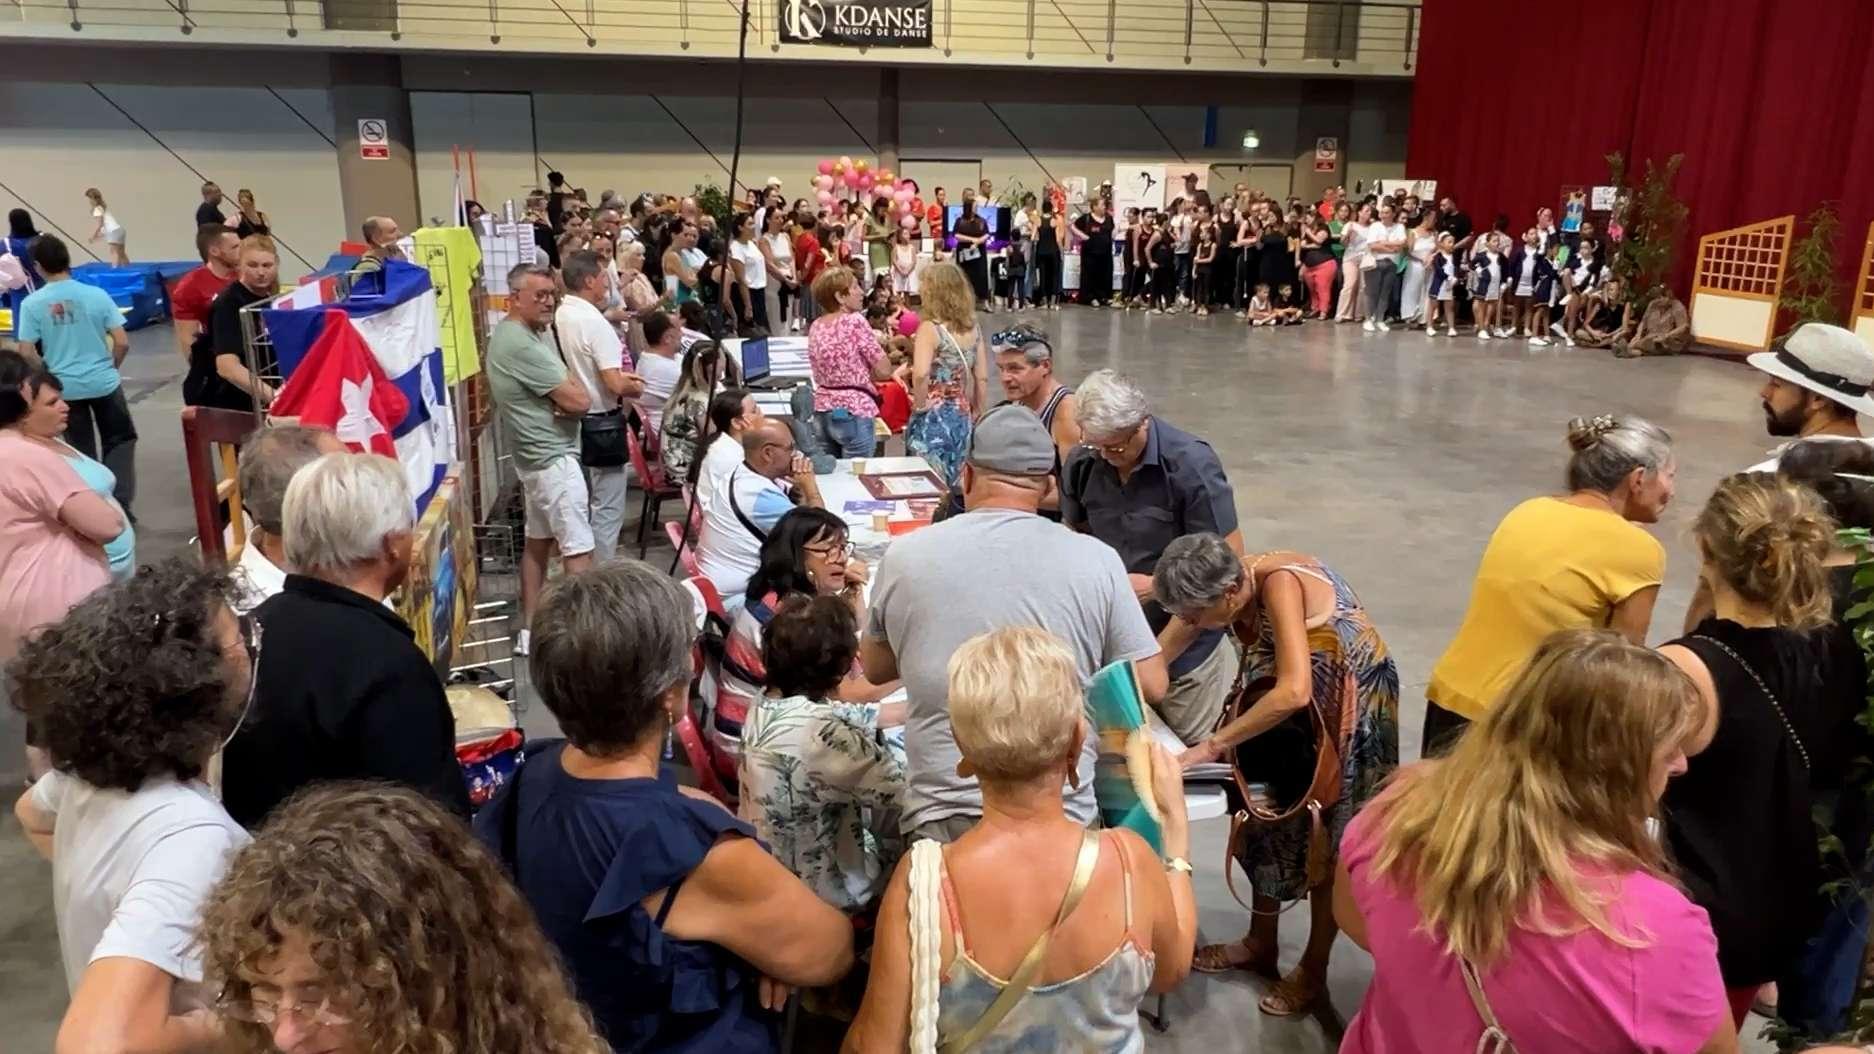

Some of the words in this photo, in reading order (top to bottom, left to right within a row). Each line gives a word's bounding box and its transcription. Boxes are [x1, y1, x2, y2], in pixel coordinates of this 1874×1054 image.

[835, 5, 927, 29] KDANSE
[833, 26, 871, 36] STUDIO
[877, 28, 889, 37] DE
[894, 29, 927, 38] DANSE
